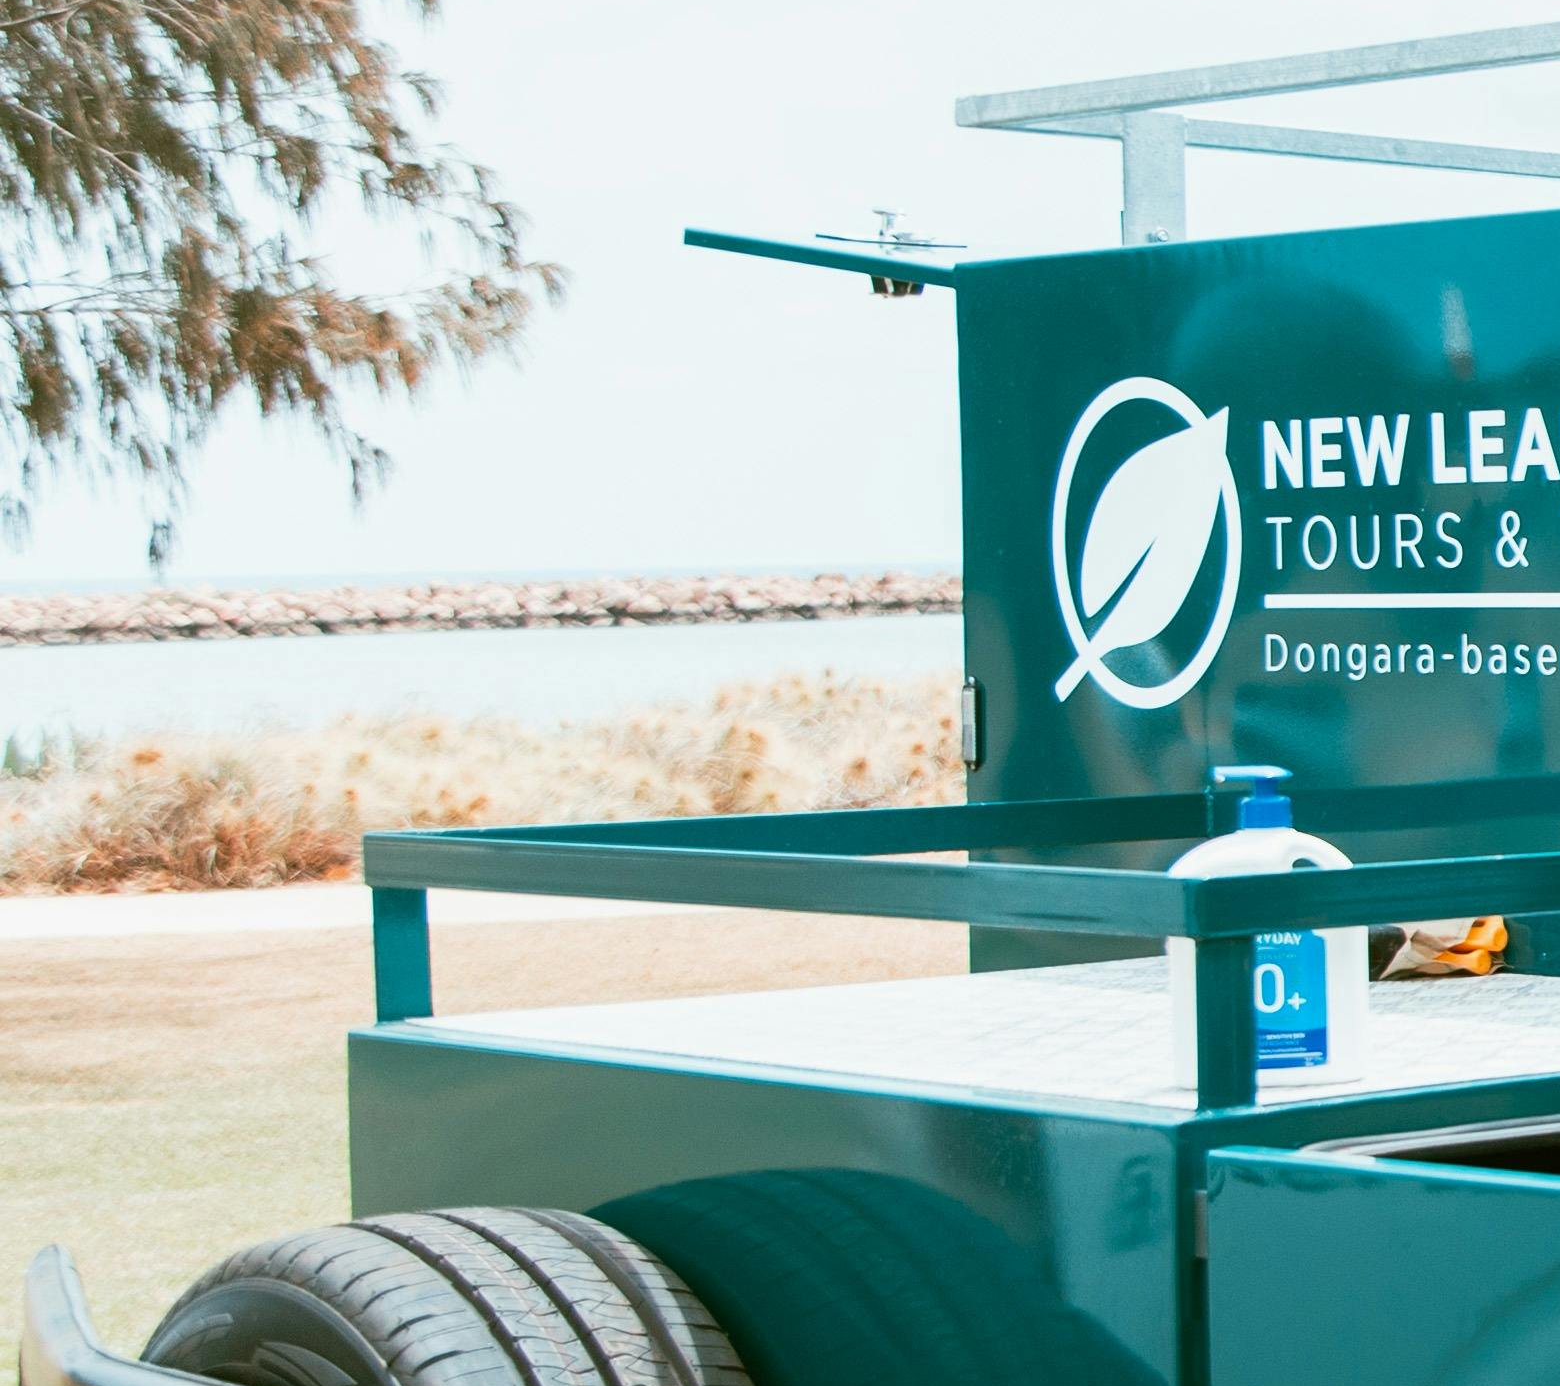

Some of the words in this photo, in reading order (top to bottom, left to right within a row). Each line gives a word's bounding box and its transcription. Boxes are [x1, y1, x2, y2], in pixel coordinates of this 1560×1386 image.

[1262, 413, 1411, 490] NEW
[1265, 510, 1464, 571] TOURS
[1496, 509, 1530, 568] &
